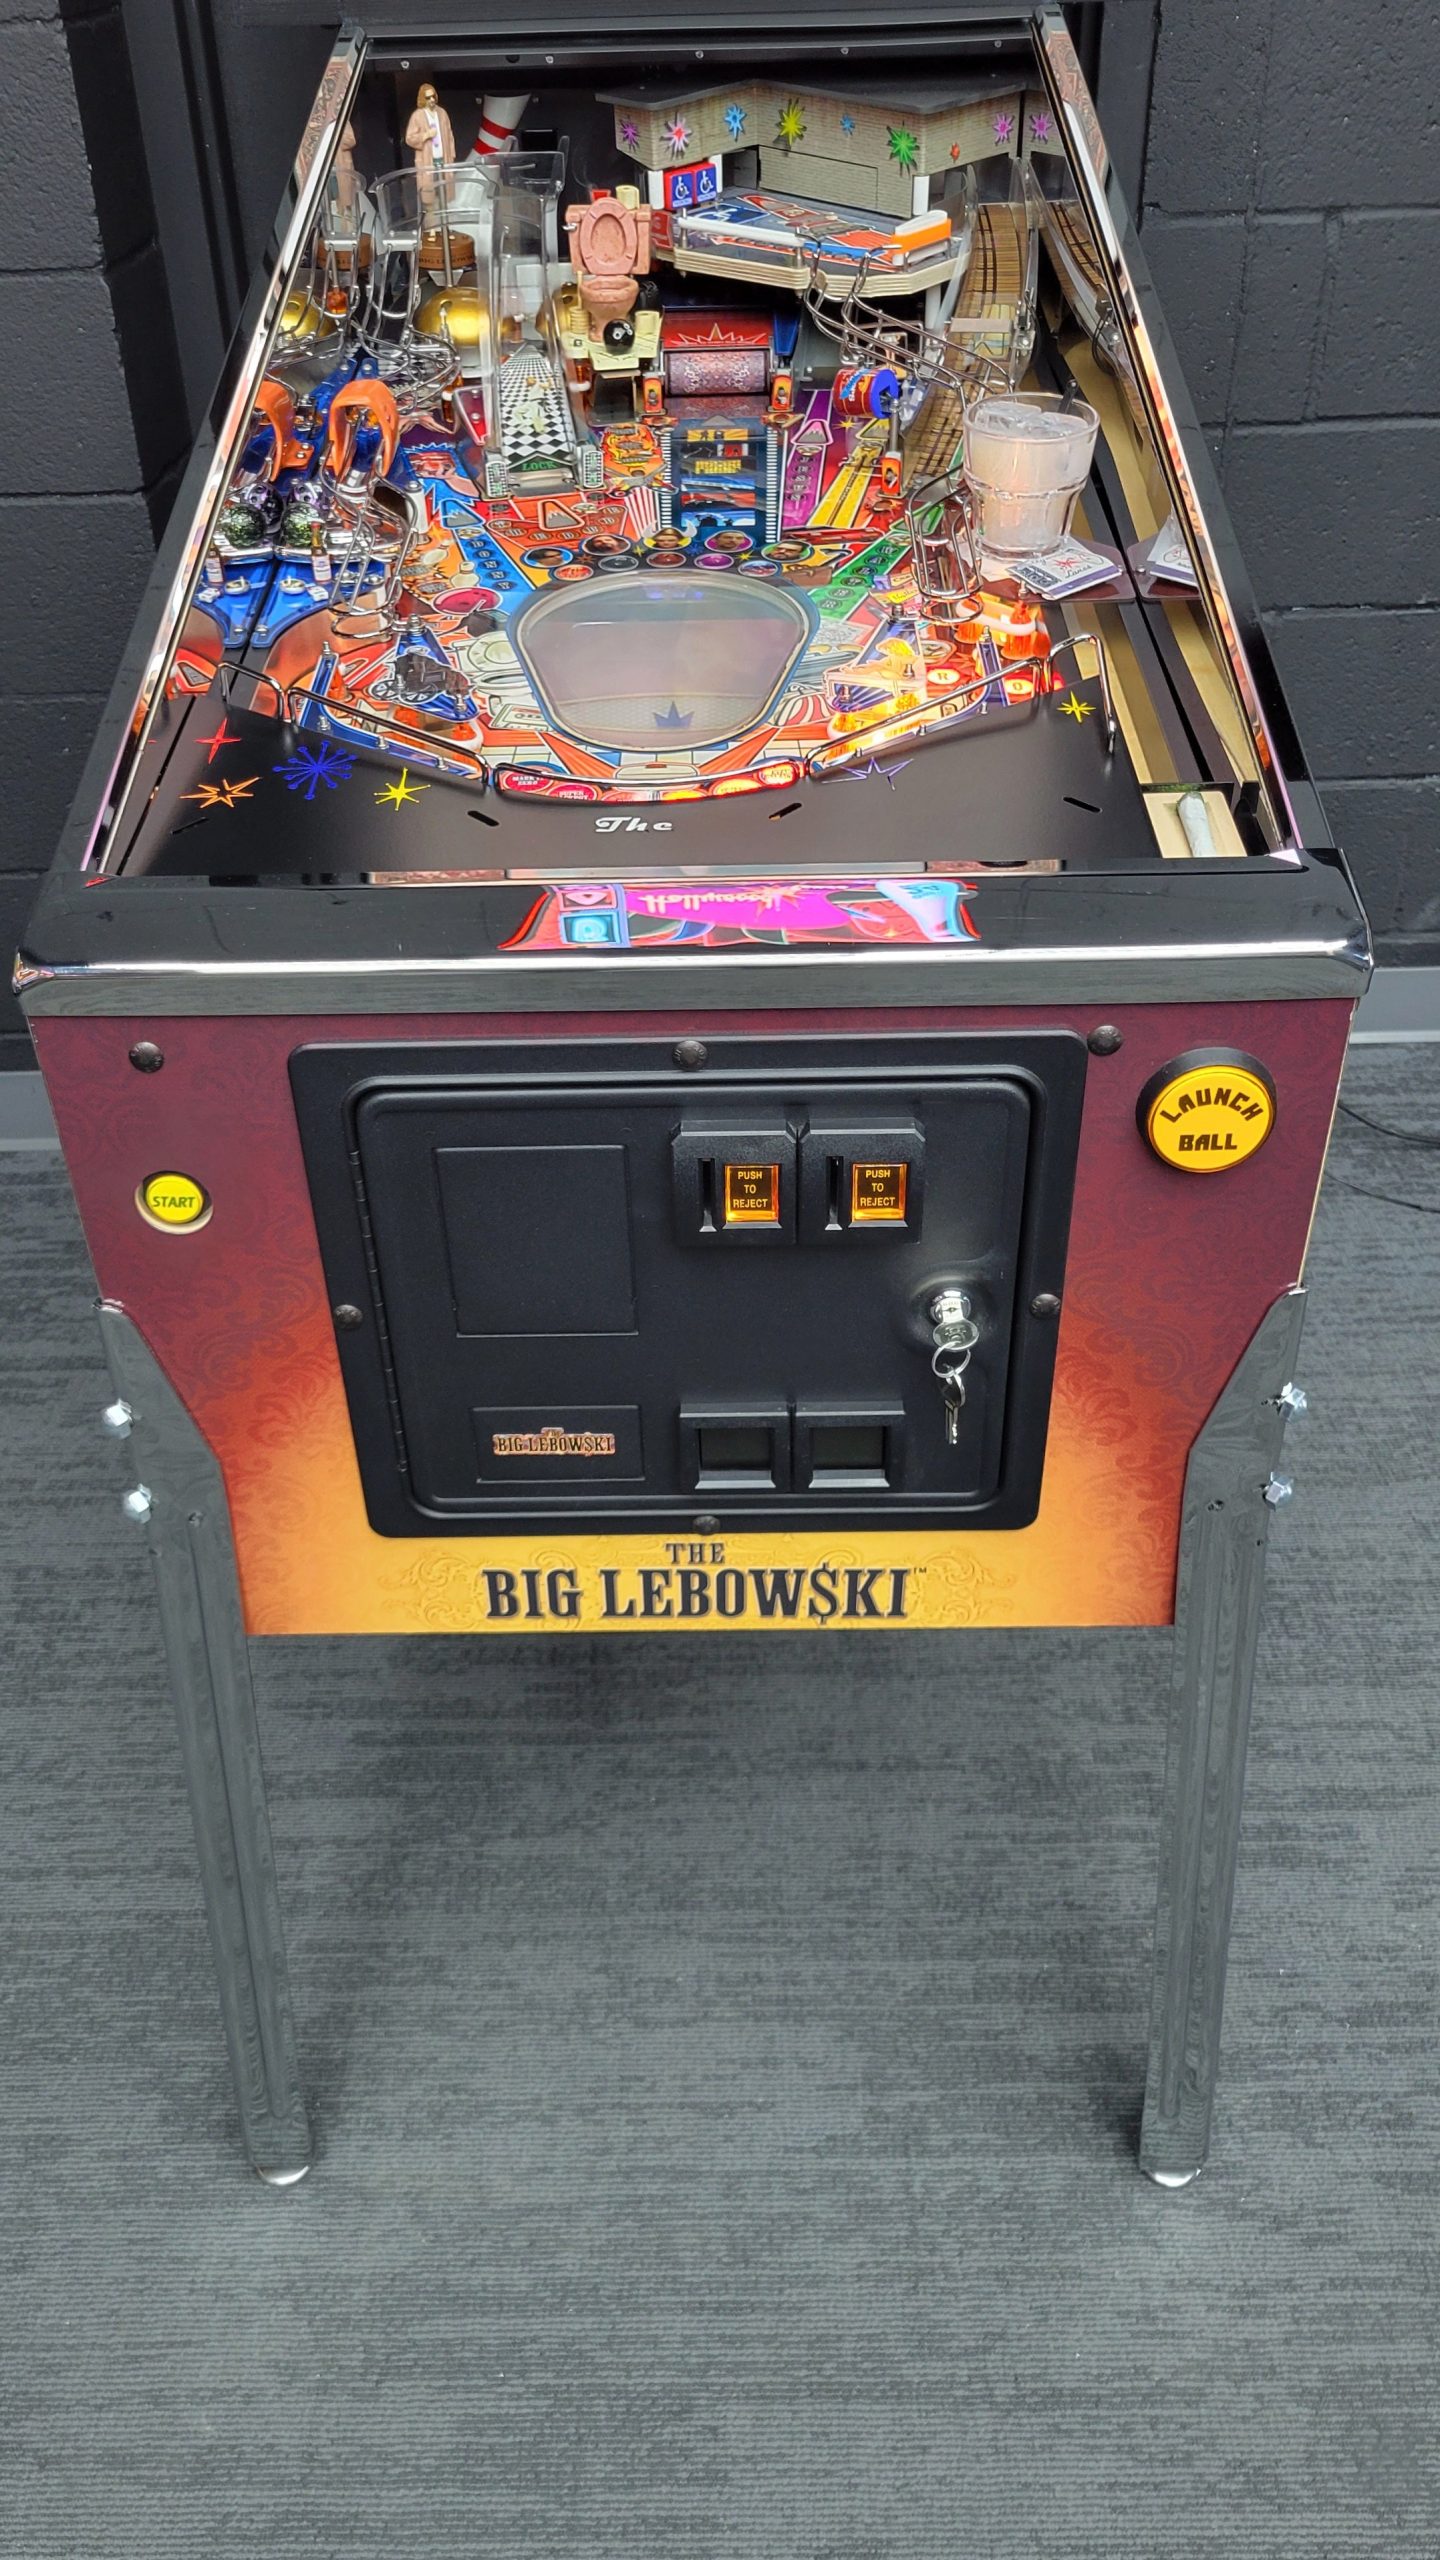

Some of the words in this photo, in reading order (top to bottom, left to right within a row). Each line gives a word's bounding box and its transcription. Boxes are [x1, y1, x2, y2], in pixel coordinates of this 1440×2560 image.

[522, 460, 557, 472] LOCK
[595, 816, 673, 833] The
[1160, 1087, 1264, 1123] LAUNCH
[1178, 1133, 1238, 1151] BALL
[737, 1170, 763, 1180] PUSH
[865, 1169, 891, 1179] PUSH
[743, 1184, 757, 1194] TO
[871, 1182, 885, 1193] TO
[152, 1196, 196, 1208] START
[732, 1198, 769, 1208] REJECT
[859, 1196, 896, 1207] REJECT
[498, 1437, 523, 1452] BIG
[665, 1542, 726, 1564] THE
[482, 1568, 583, 1619] BIG
